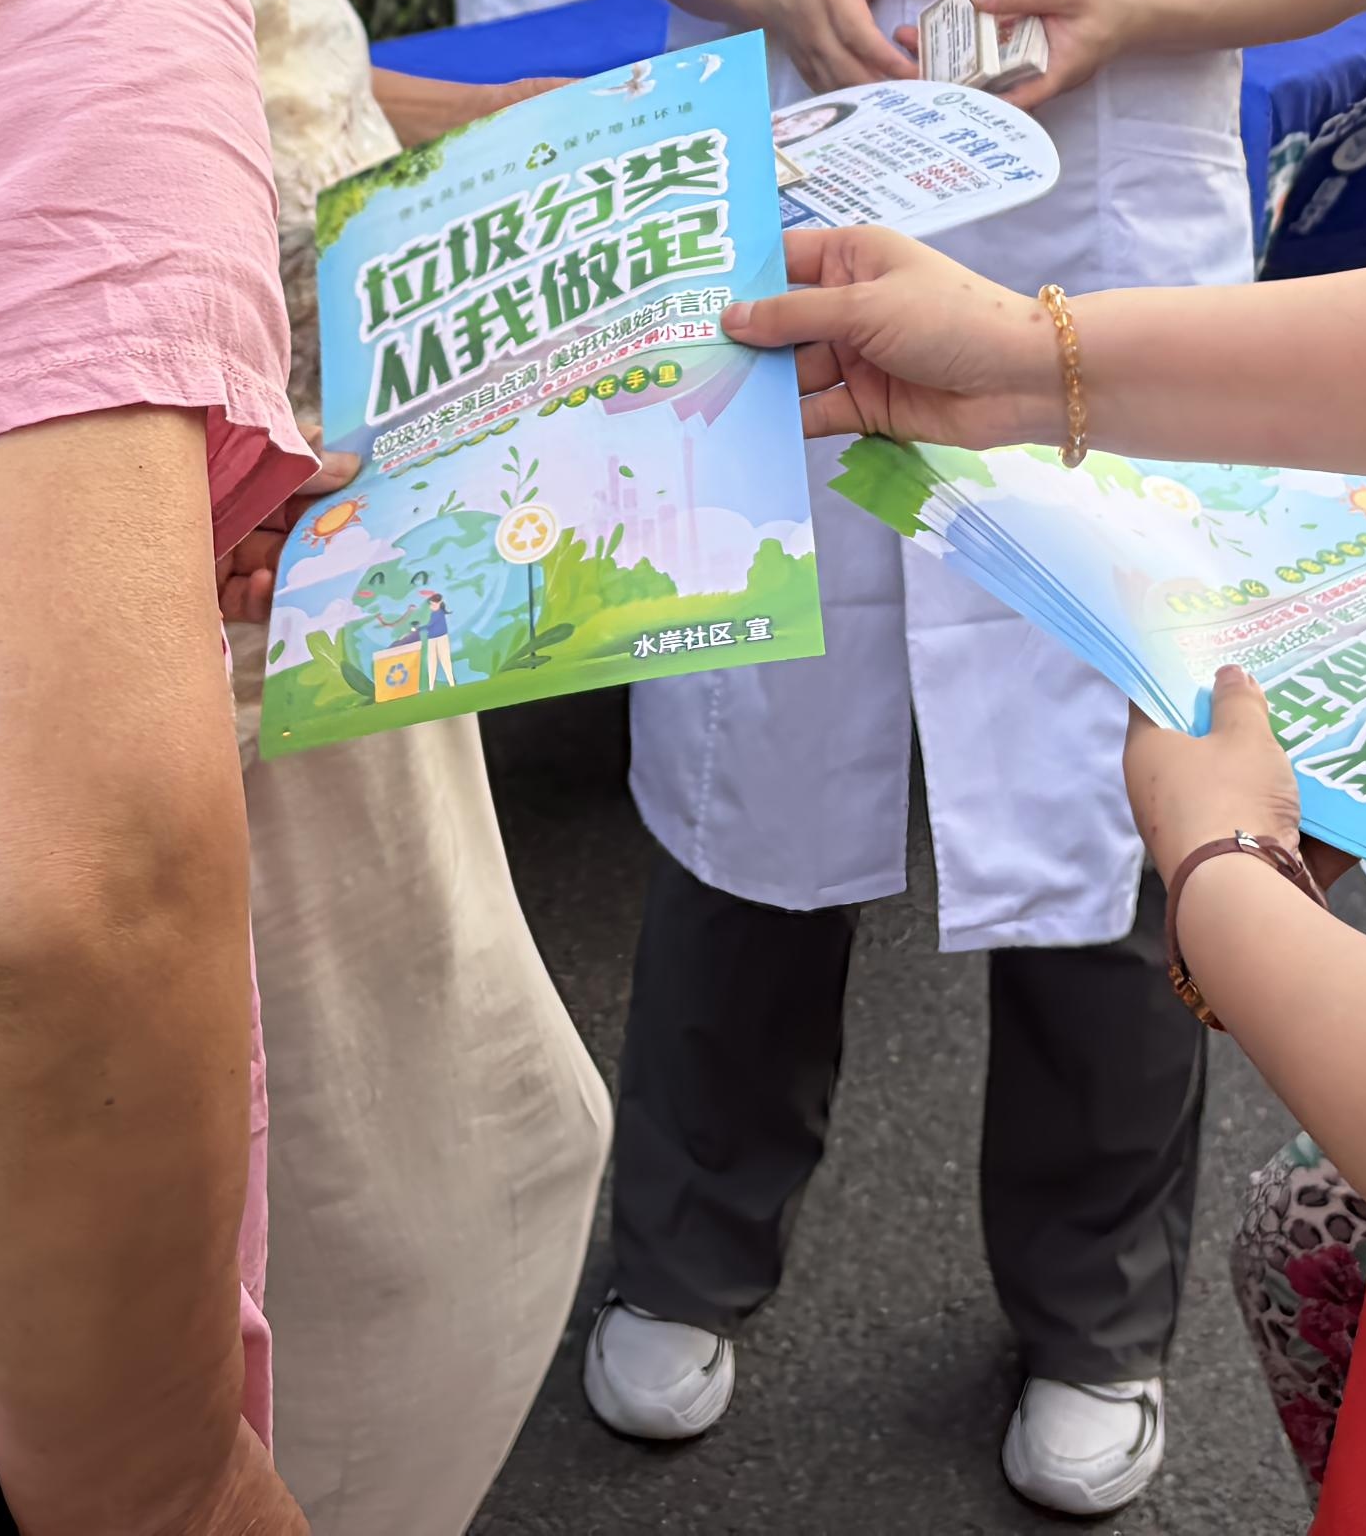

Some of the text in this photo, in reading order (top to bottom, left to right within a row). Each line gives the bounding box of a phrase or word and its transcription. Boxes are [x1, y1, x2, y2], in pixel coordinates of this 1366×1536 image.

[363, 135, 721, 334] 垃圾分类
[373, 207, 725, 419] 从我做起
[548, 288, 730, 372] 美好环境始于言行
[633, 617, 772, 658] 水岸社区 宣
